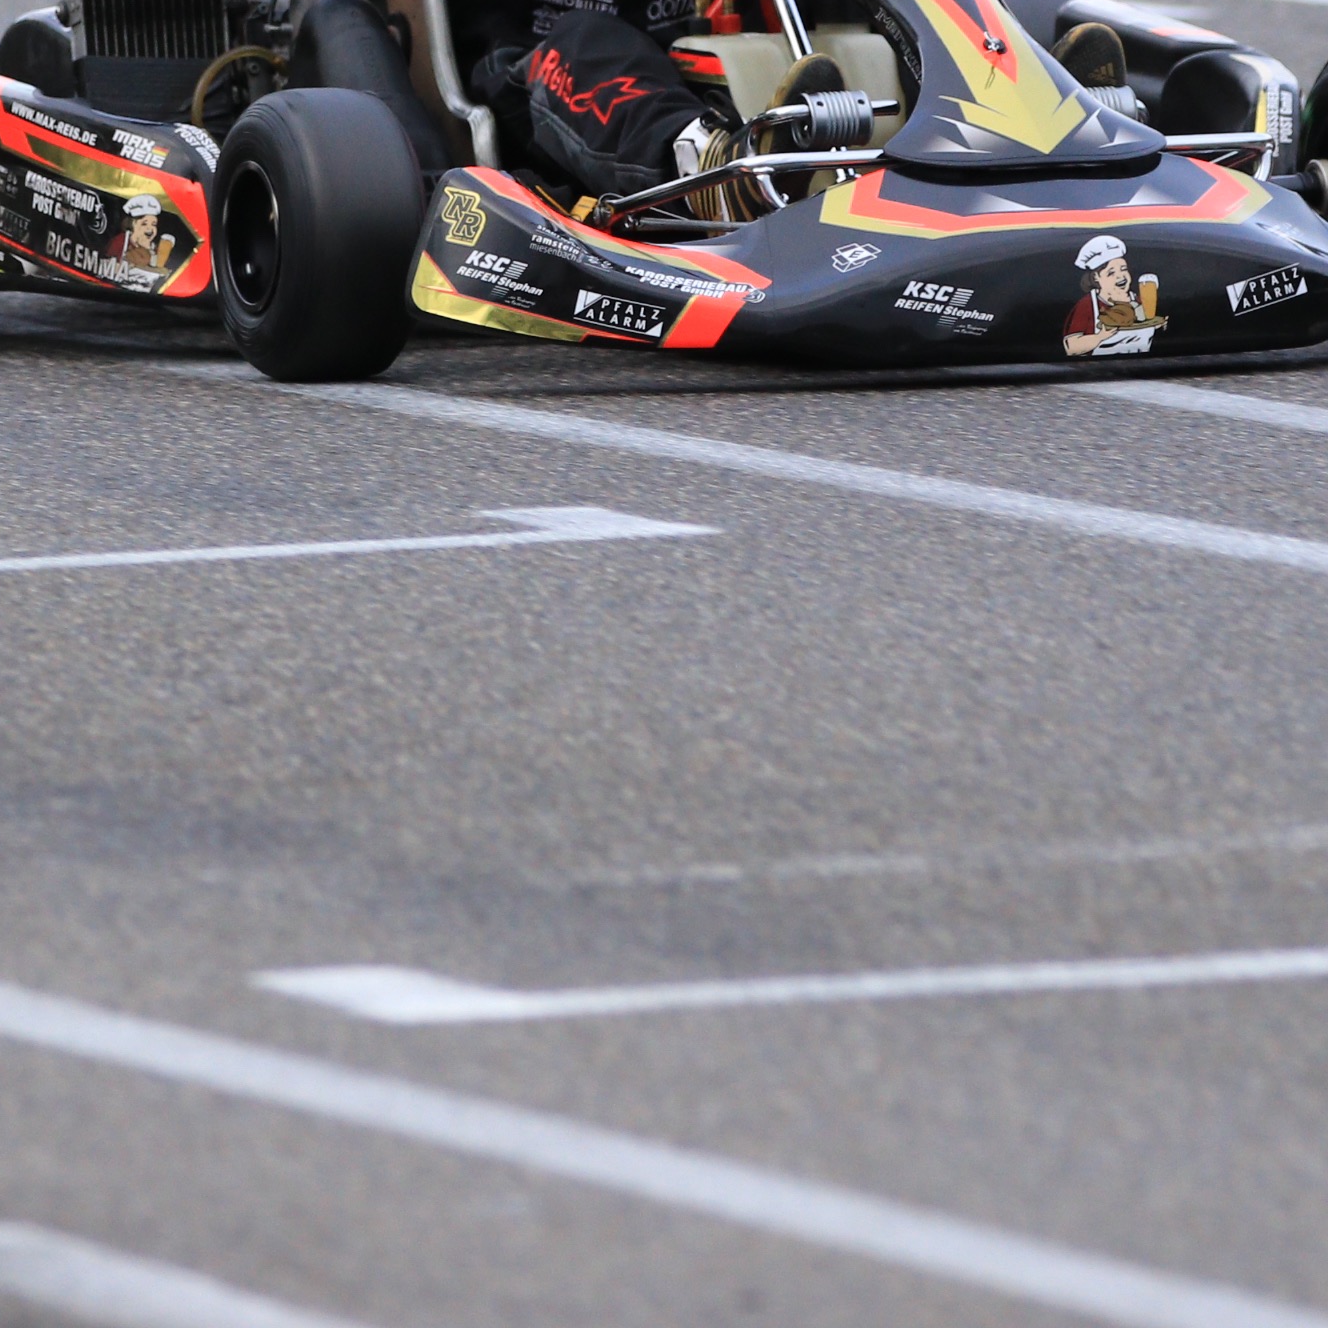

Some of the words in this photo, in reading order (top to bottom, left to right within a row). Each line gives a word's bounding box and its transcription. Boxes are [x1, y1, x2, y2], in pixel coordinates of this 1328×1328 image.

[10, 101, 97, 147] WWW.MAX-REIS.DE
[112, 128, 155, 152] MAX
[120, 145, 167, 169] REIS
[32, 193, 55, 216] POST
[529, 242, 577, 264] miesenbach
[531, 233, 580, 255] ramstein
[46, 230, 72, 263] BIG
[73, 243, 130, 283] EMMA
[465, 250, 511, 273] KSC
[456, 265, 500, 284] REIFEN
[497, 276, 544, 296] Stephan
[624, 265, 748, 294] KAROSSERIEBAU
[639, 276, 676, 293] POST
[675, 285, 725, 299] GmbH
[903, 280, 955, 302] KSC
[1248, 267, 1300, 293] PFALZ
[1242, 283, 1295, 309] ALARM
[586, 311, 647, 331] ALARM
[601, 299, 660, 321] PFALZ
[894, 298, 945, 314] REIFEN
[943, 305, 994, 322] Stephan
